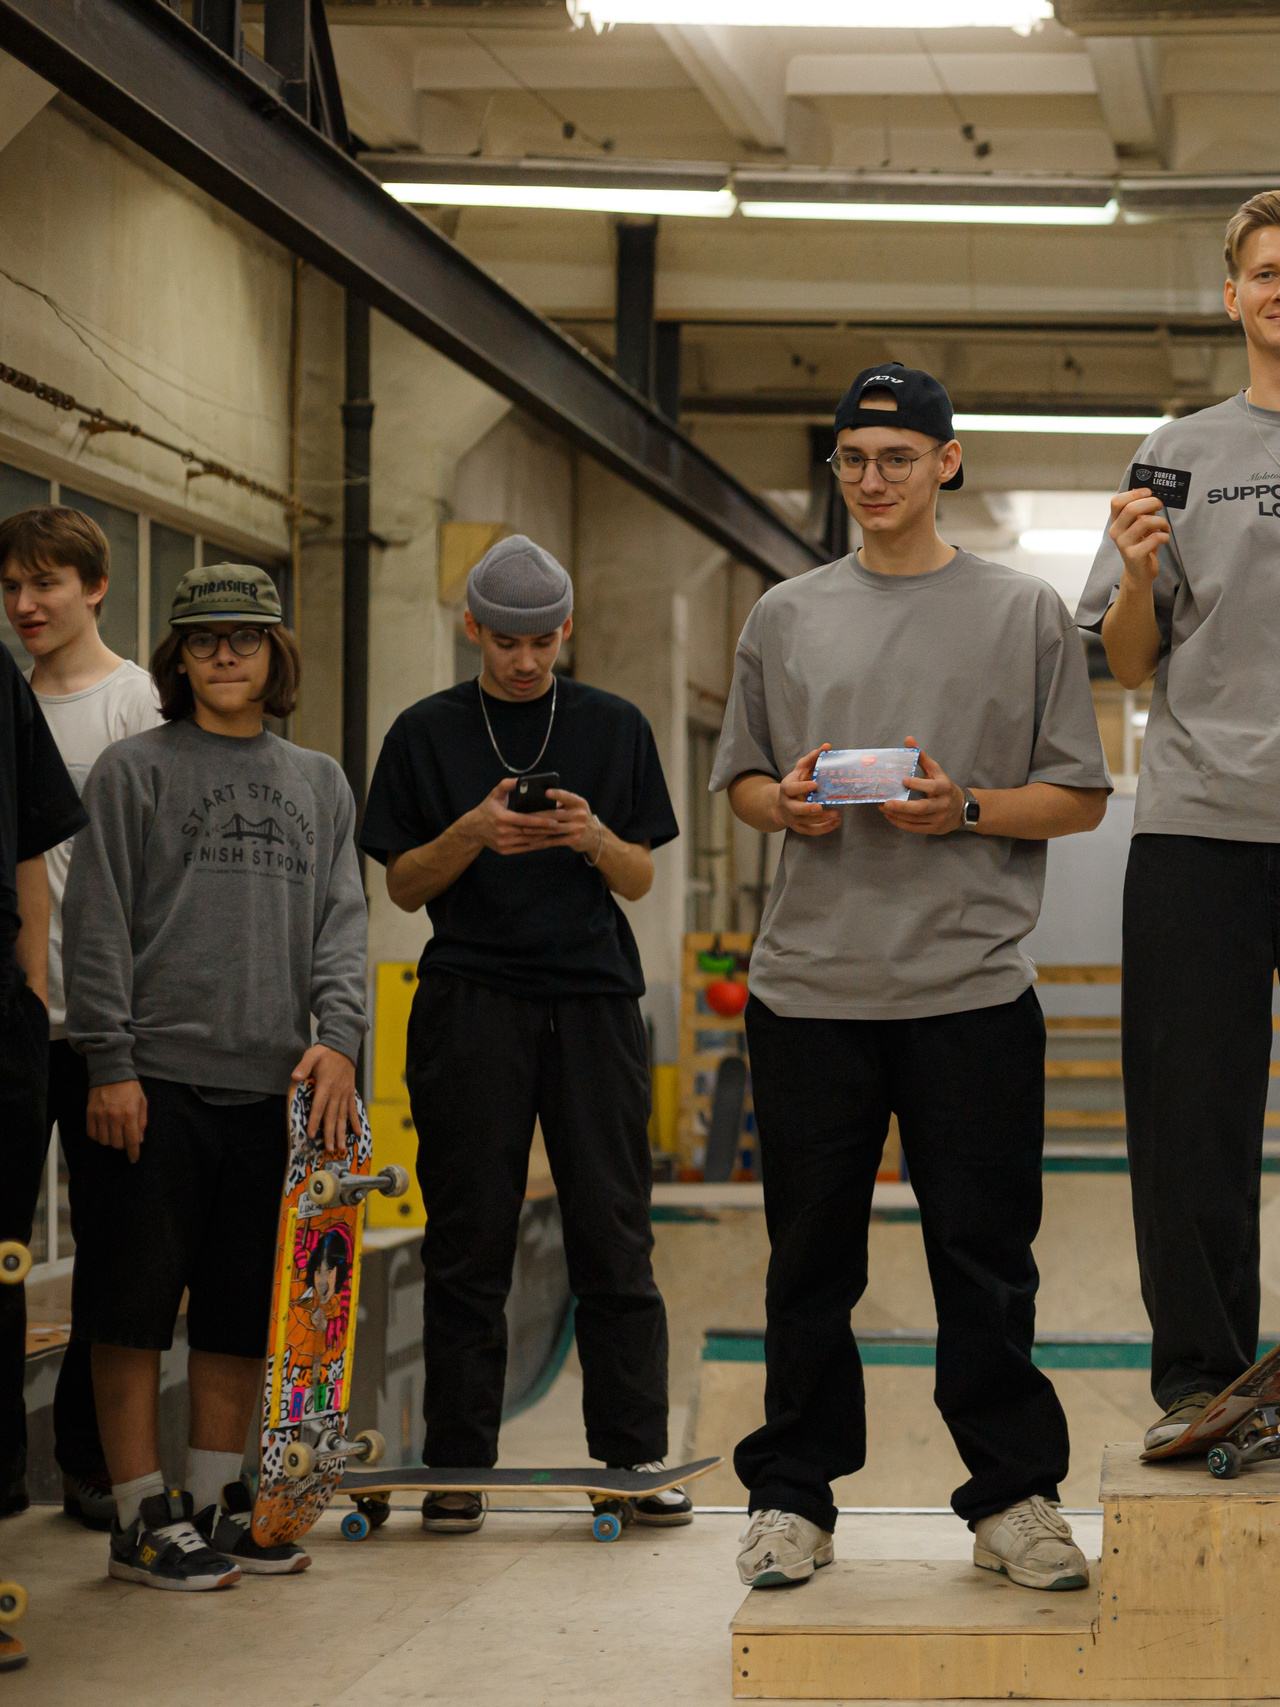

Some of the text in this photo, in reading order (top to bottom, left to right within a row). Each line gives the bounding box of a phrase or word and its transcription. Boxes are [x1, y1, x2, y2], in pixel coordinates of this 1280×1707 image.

[1152, 478, 1177, 488] LICENSE
[1154, 471, 1177, 481] SURFER
[188, 580, 259, 603] THRASHER
[182, 782, 315, 846] START STRONG
